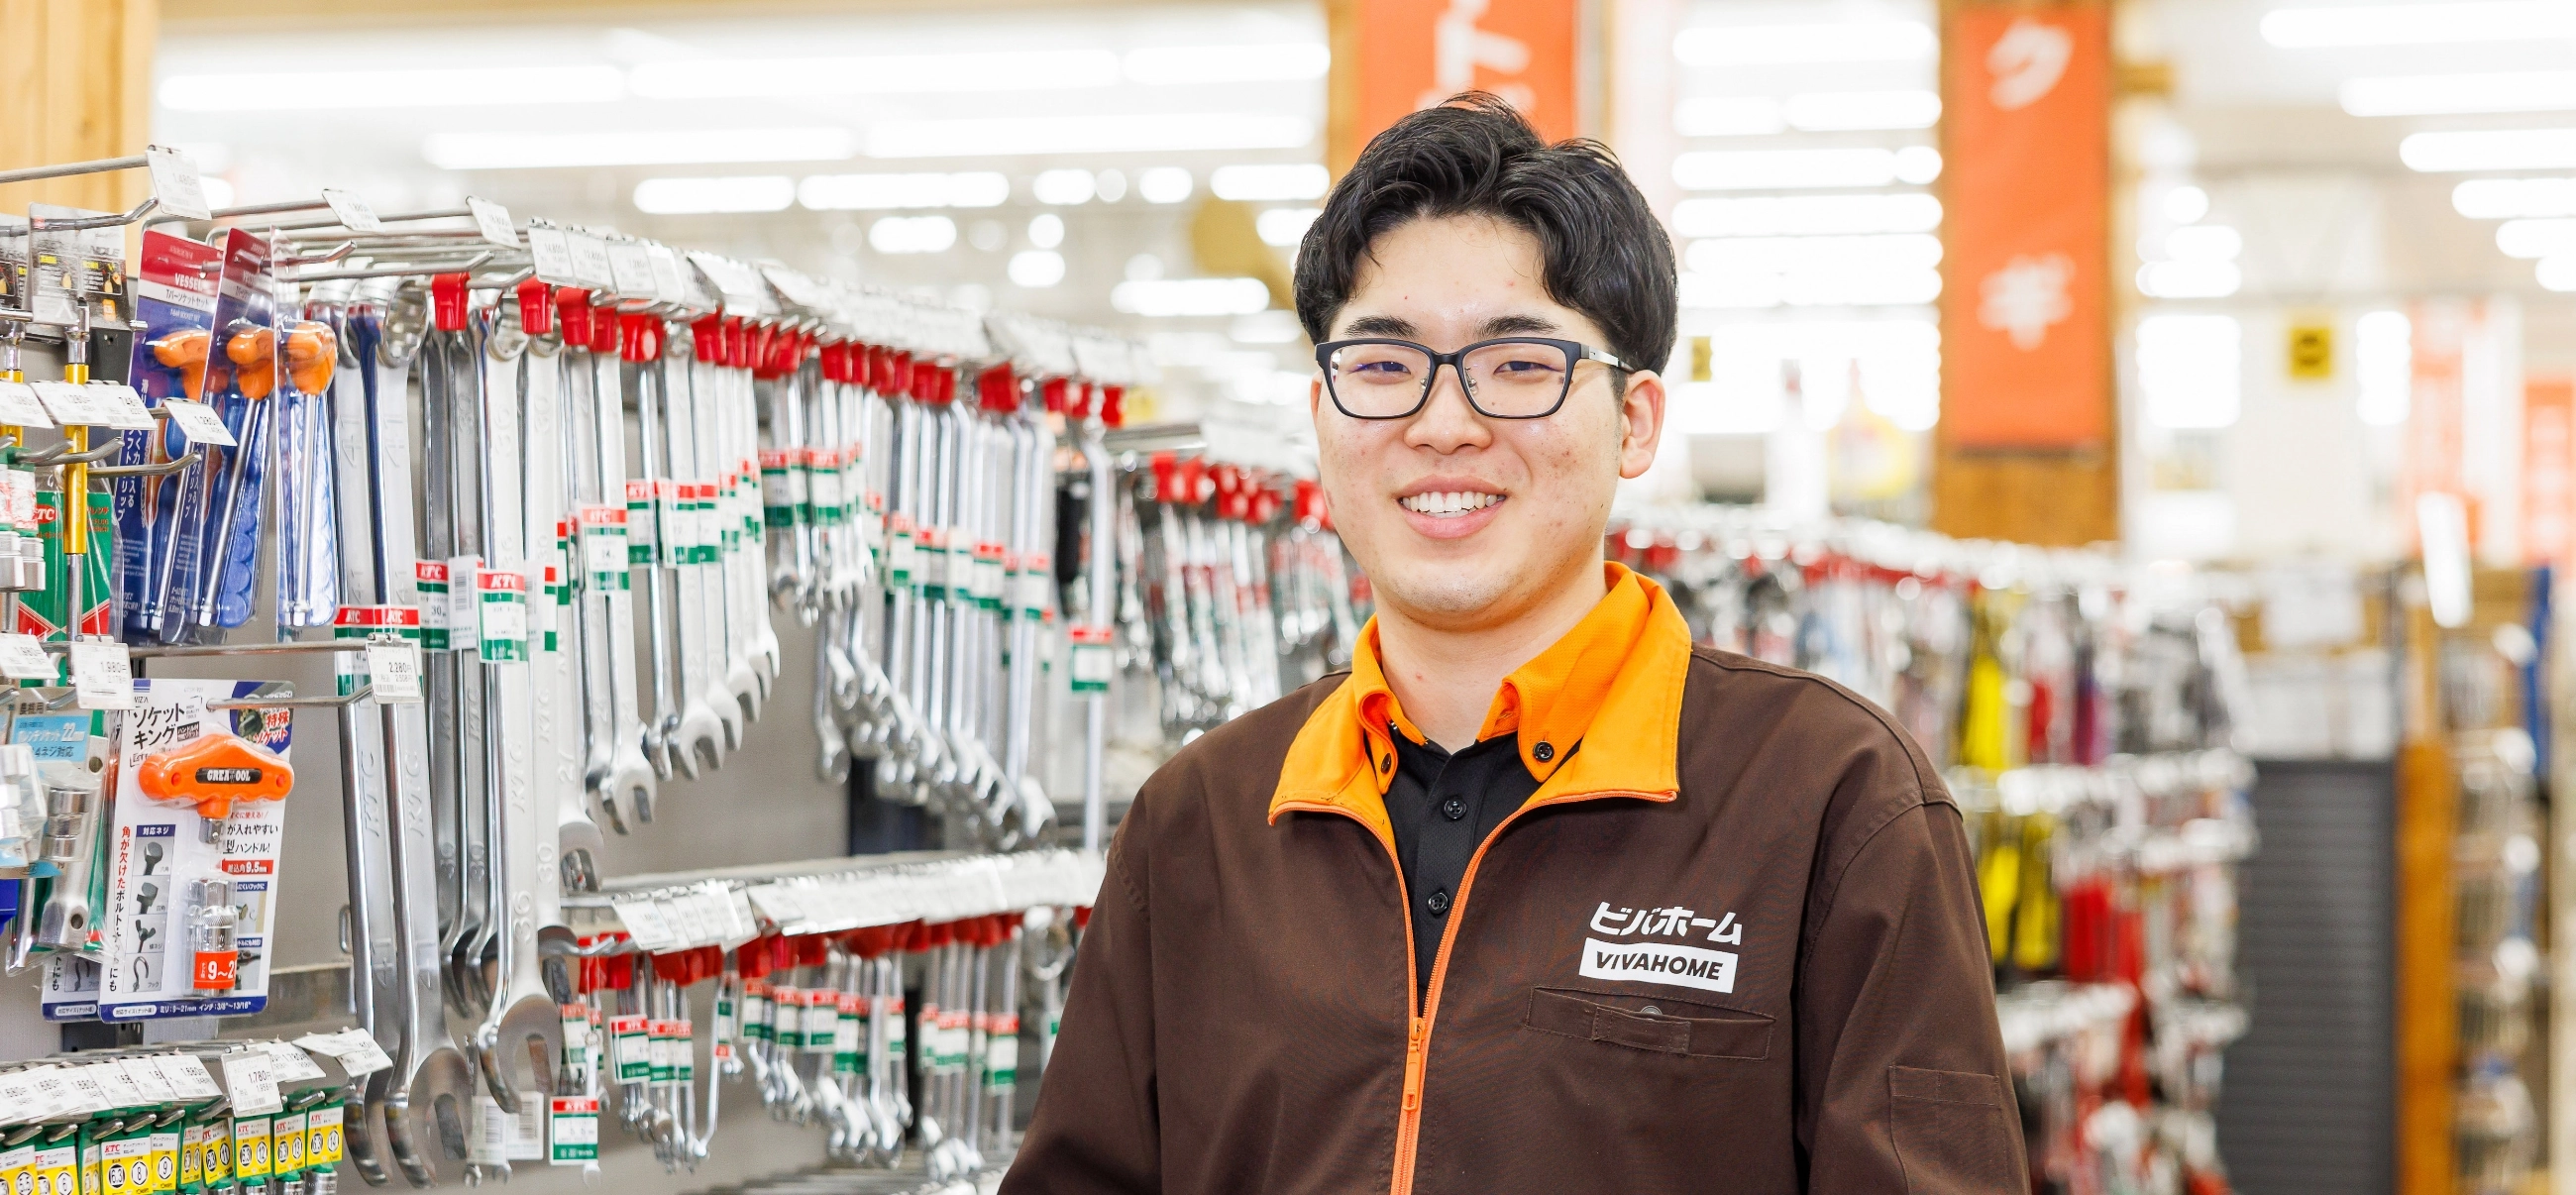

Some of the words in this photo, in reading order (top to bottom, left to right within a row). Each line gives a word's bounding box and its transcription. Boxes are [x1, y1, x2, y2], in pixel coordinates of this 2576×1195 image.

[420, 566, 442, 580] KTC
[100, 661, 127, 674] 1,980円
[388, 662, 413, 674] 2,280円
[133, 703, 185, 728] ソケット
[266, 710, 290, 728] 特殊
[133, 723, 176, 750] キング
[254, 728, 289, 745] ソケット
[33, 745, 74, 758] 4ネジ対応
[143, 825, 169, 835] 対応ネジ
[227, 823, 278, 835] が入れやすい
[223, 839, 270, 854] 型ハンドル!
[1589, 901, 1743, 946] ビバホーム
[1596, 951, 1724, 981] VIVAHOME
[248, 1069, 272, 1084] 1,780円
[105, 1143, 121, 1152] KTC
[111, 1168, 123, 1184] 6.3
[137, 1166, 143, 1181] 8
[162, 1160, 168, 1175] 9
